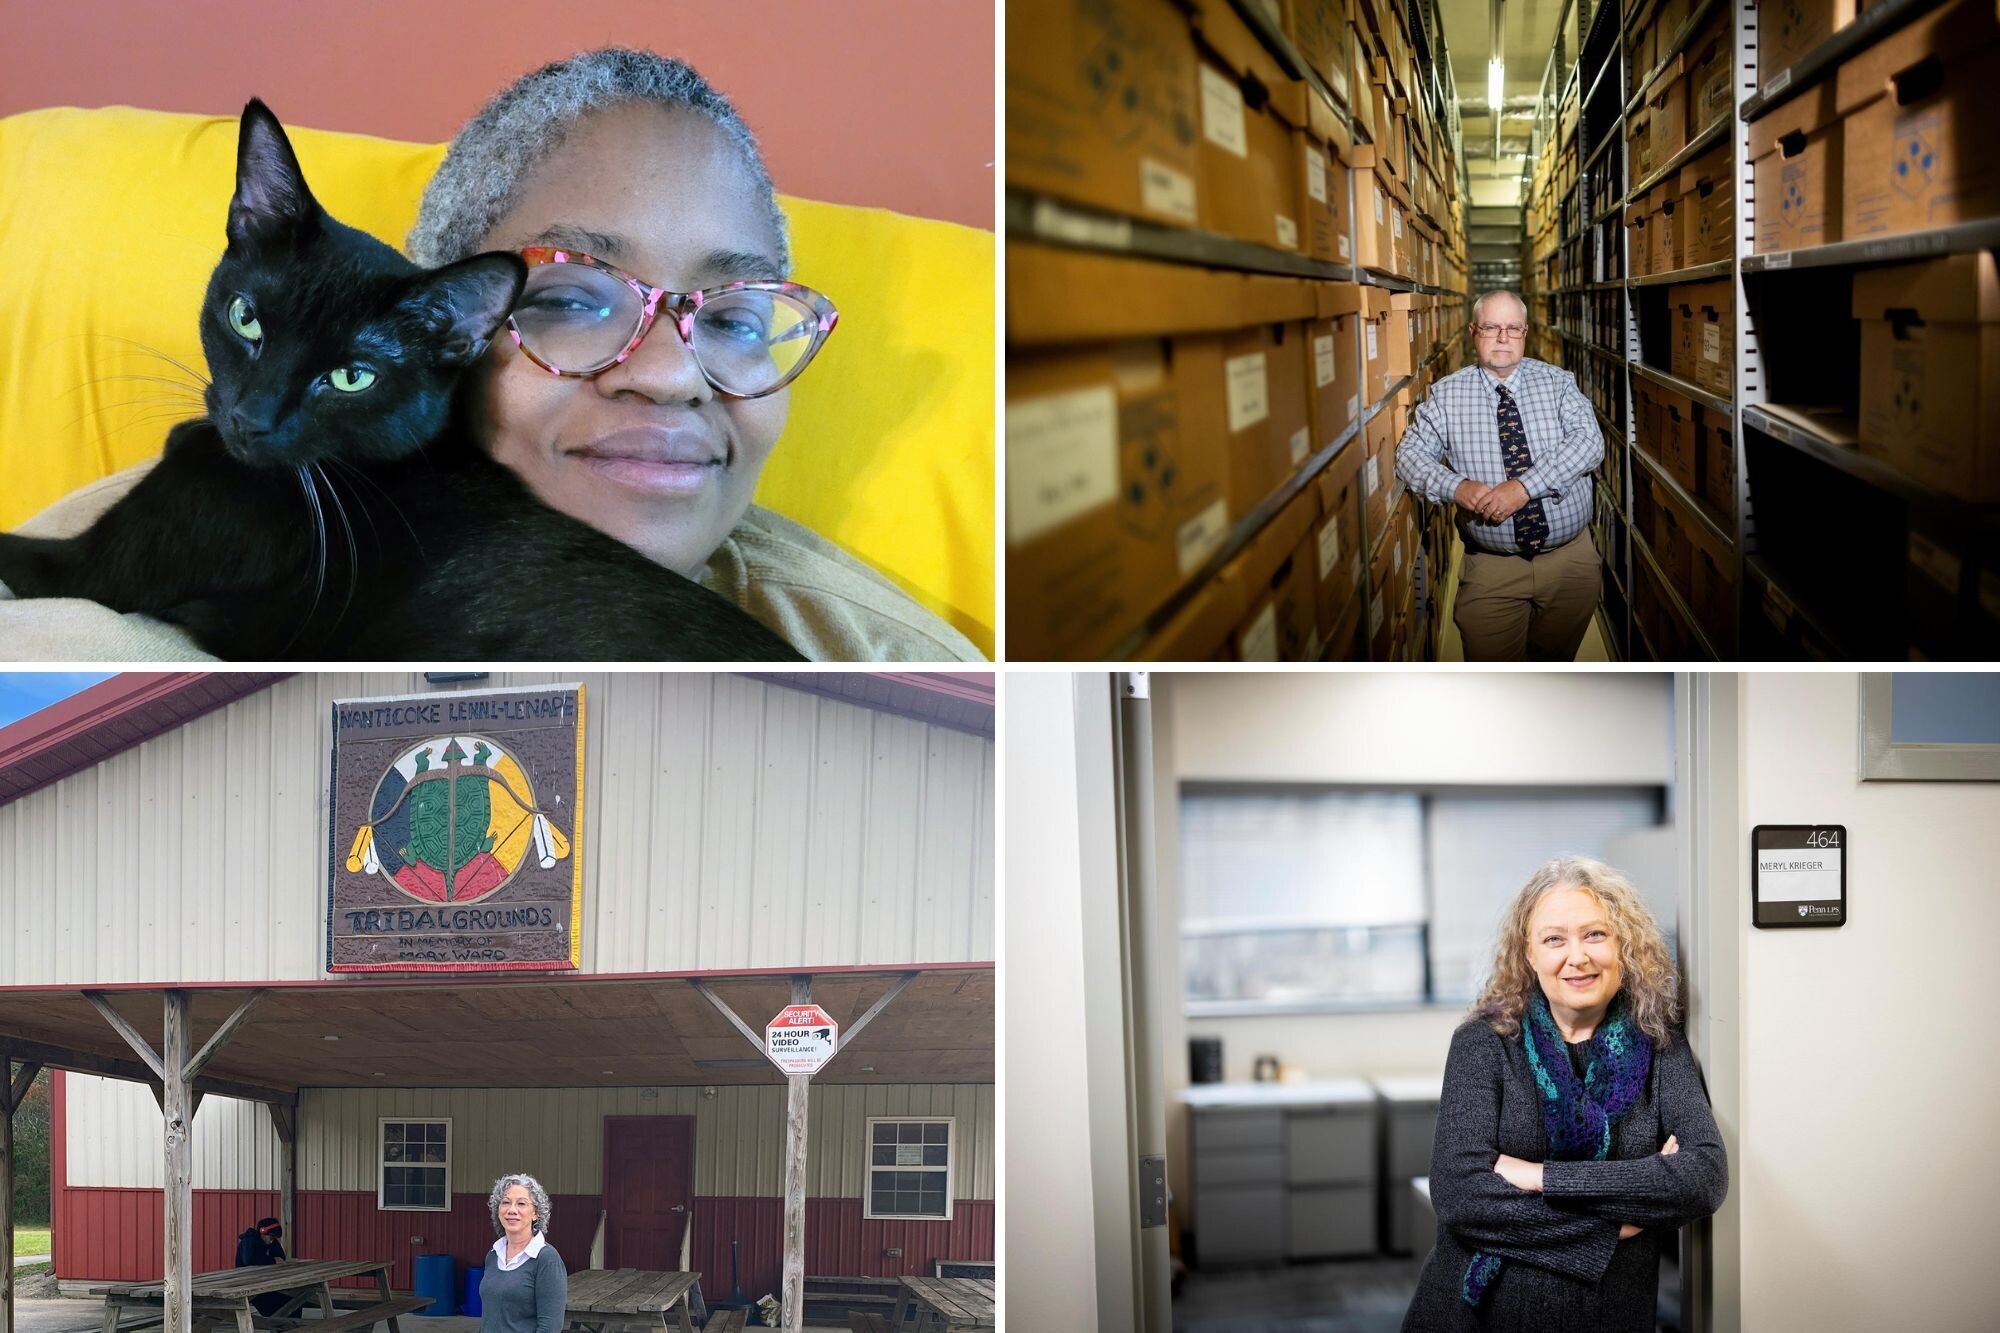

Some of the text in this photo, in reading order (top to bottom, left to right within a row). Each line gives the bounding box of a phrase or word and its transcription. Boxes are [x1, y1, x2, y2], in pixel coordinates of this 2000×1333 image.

[340, 696, 574, 729] NANTICOKE LENNI-LENAPE
[1806, 831, 1839, 848] 464
[1760, 861, 1823, 870] MERYL KRIEGER
[400, 936, 493, 948] IN MEMORY OF
[400, 949, 506, 961] MARY WARD
[784, 1010, 819, 1018] SECURITY
[784, 1030, 810, 1038] HOUR
